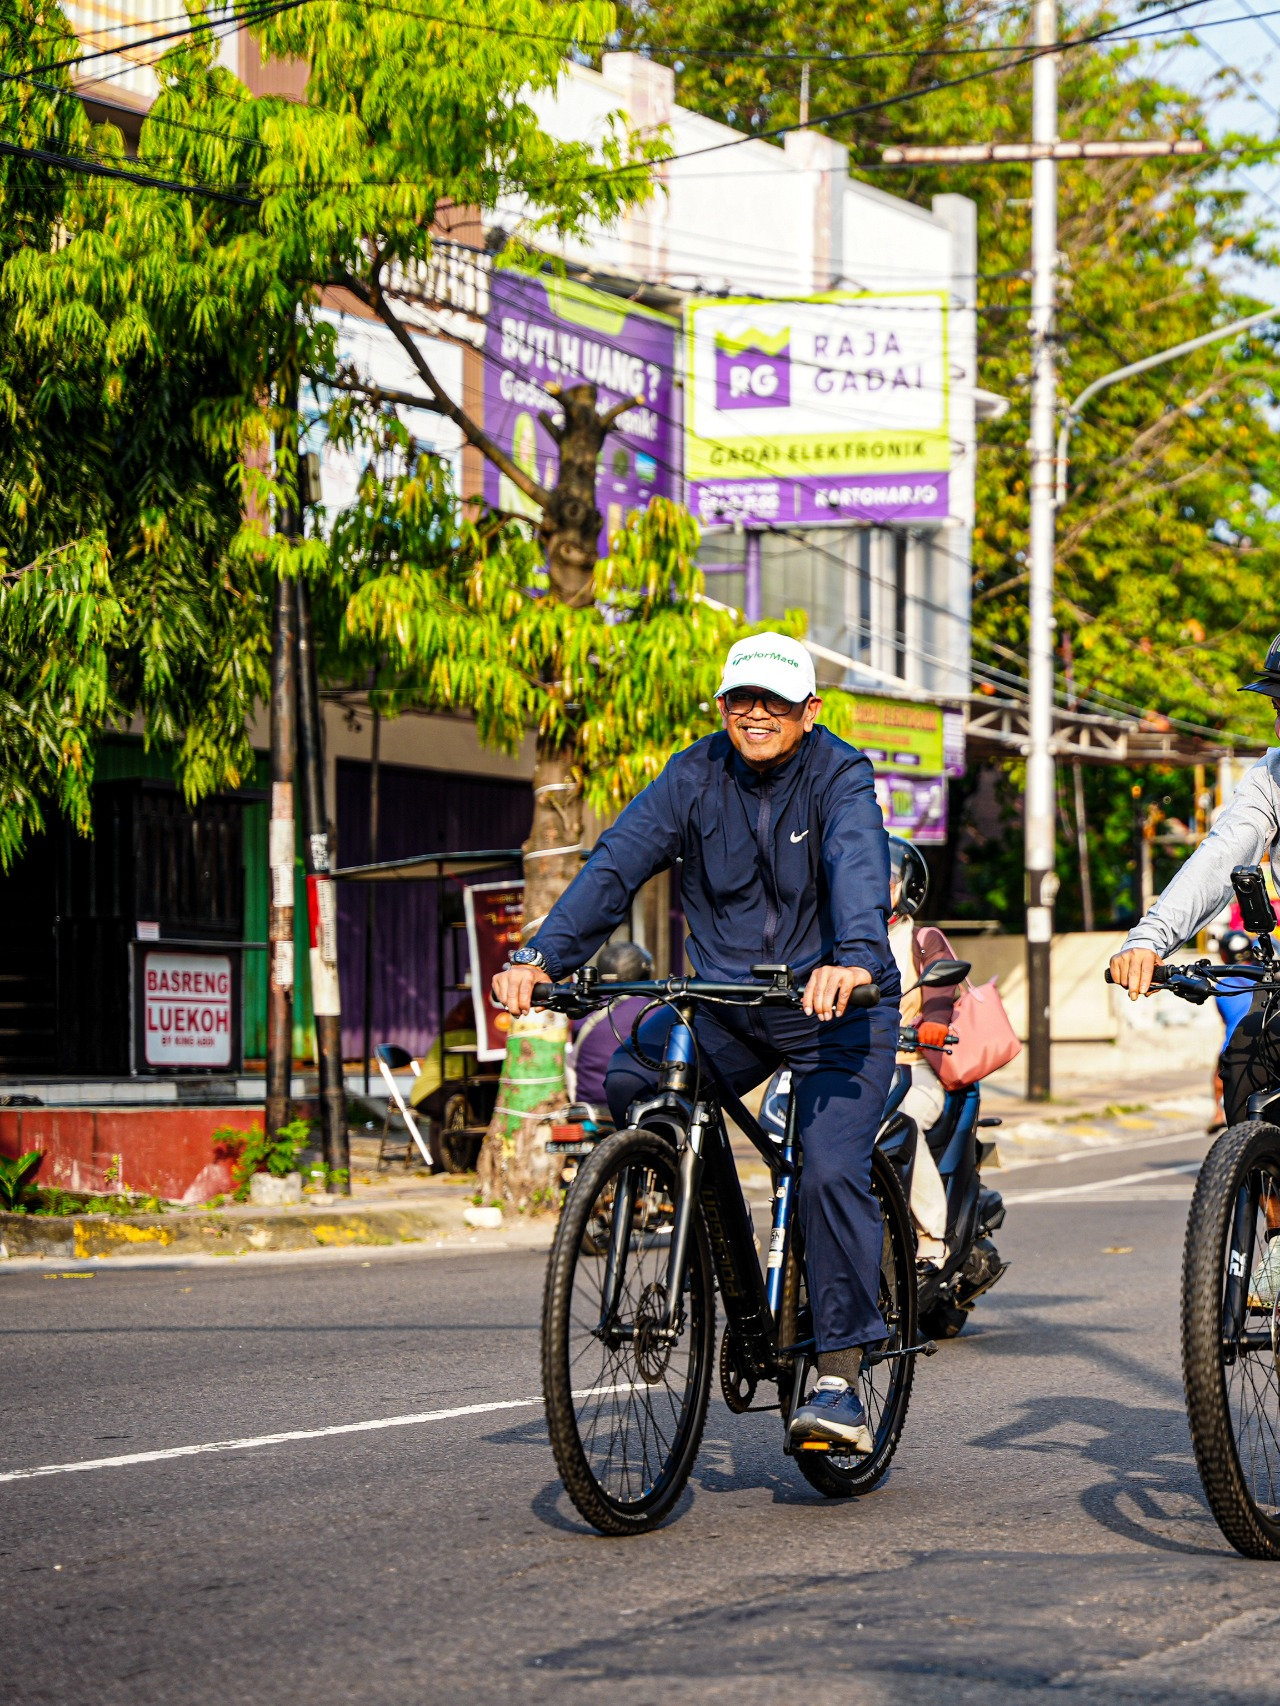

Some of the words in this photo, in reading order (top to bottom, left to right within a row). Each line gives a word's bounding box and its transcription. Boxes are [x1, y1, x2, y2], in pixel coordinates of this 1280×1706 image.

[814, 330, 902, 357] RAJA
[582, 340, 645, 398] UANG
[729, 365, 779, 398] RG
[814, 365, 922, 394] GADAI
[709, 444, 783, 465] GADAI
[786, 440, 926, 462] ELEKTRONIK
[147, 970, 229, 994] BASRENG
[147, 1007, 230, 1033] LUEKOH
